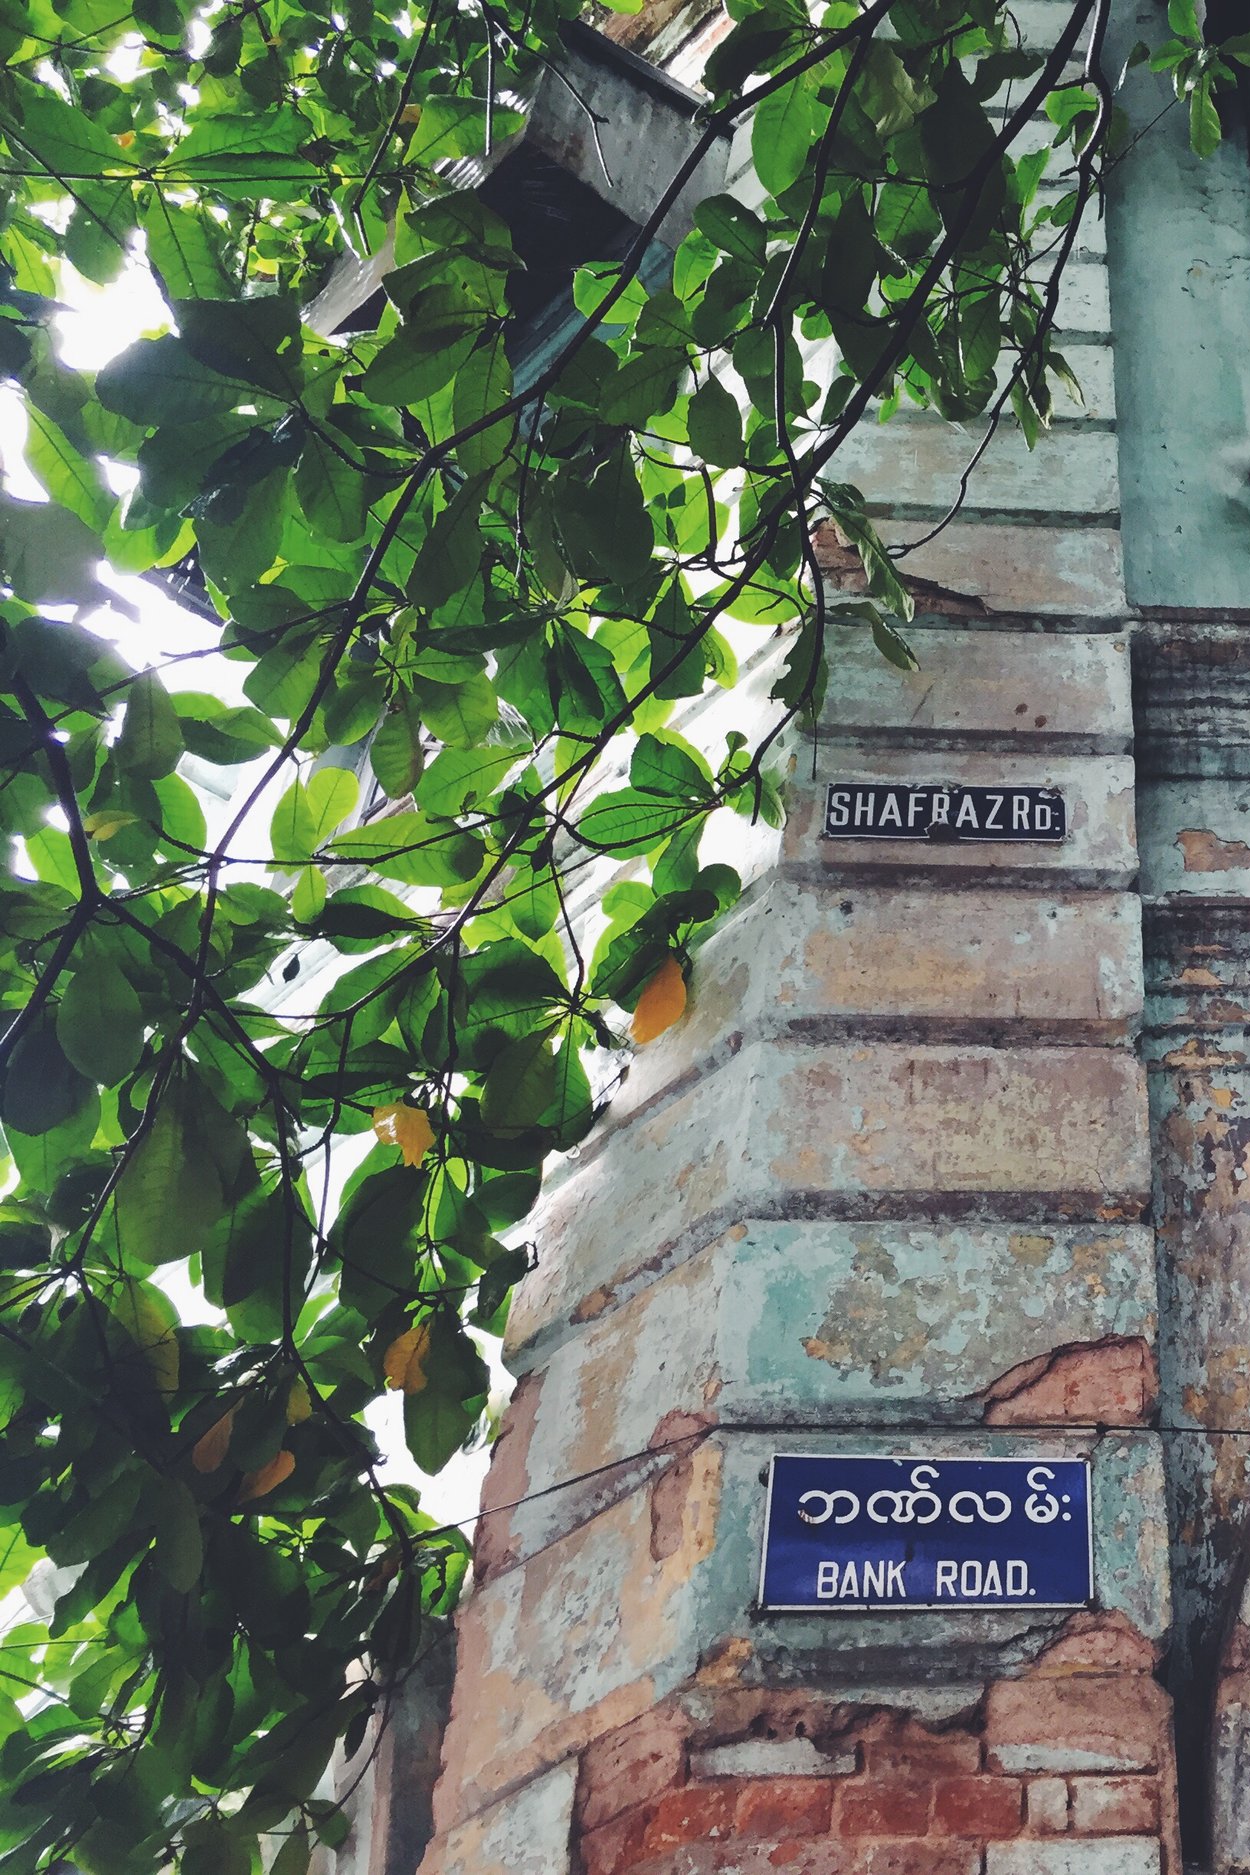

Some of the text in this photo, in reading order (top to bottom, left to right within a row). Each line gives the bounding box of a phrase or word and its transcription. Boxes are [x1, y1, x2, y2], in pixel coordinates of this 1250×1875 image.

[830, 792, 1004, 830] SHAFRAZ
[816, 1559, 1037, 1599] BANK ROAD.
